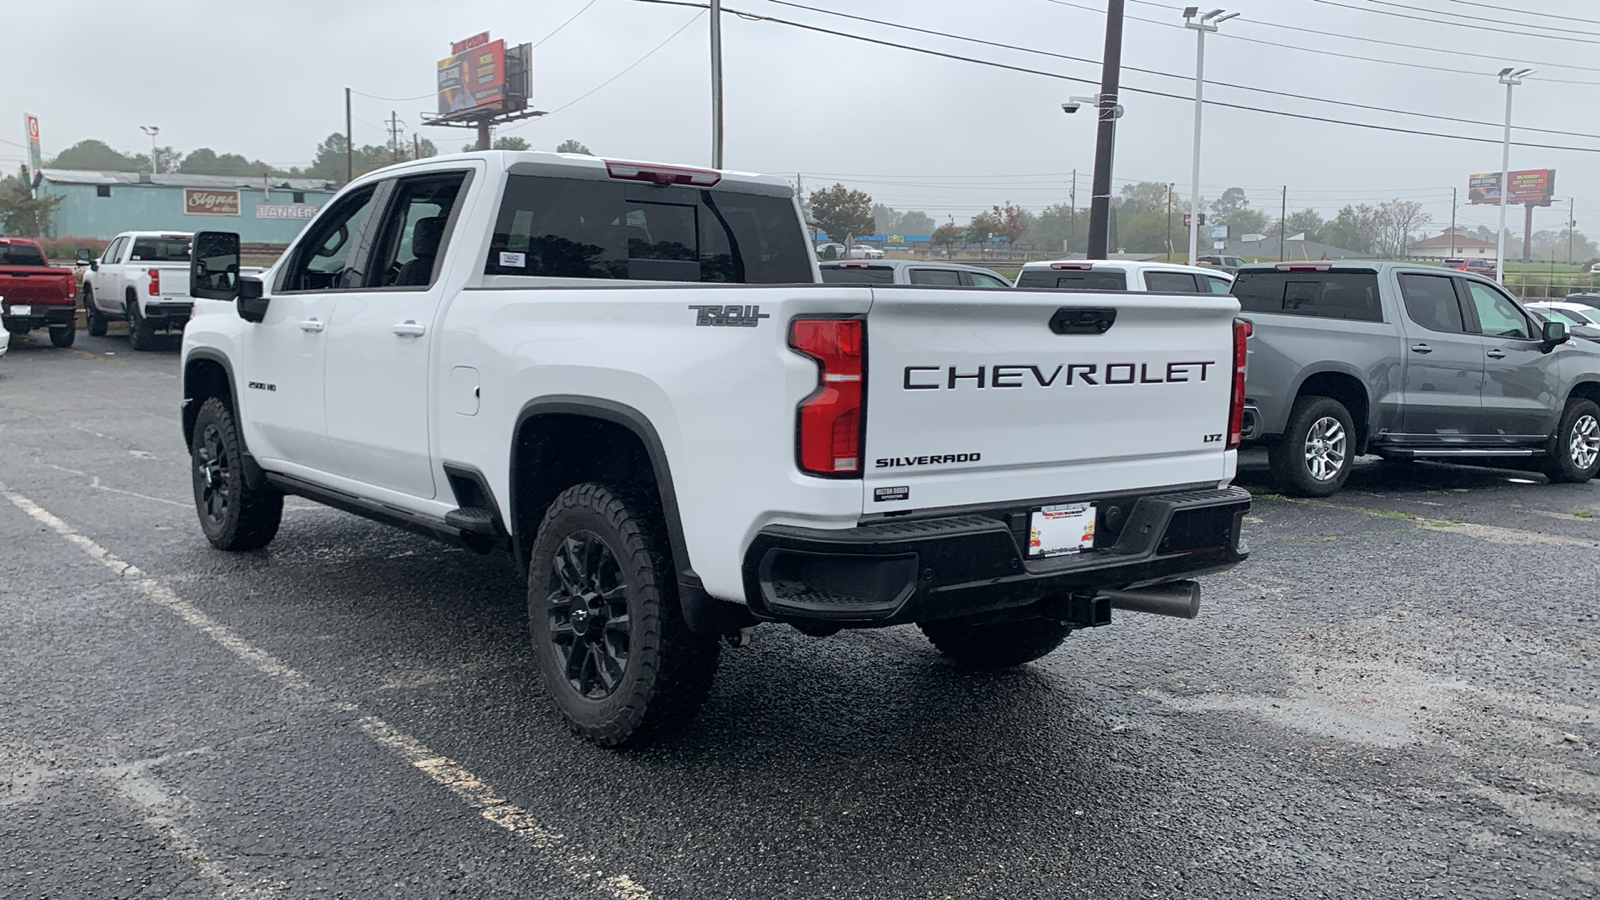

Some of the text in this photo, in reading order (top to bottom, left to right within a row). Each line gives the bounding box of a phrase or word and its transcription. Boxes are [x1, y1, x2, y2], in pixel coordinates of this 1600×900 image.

[188, 192, 235, 208] Signs
[688, 305, 770, 318] TRAIL
[696, 317, 758, 327] BOSS
[903, 361, 1215, 390] CHEVROLET
[248, 381, 276, 392] 2500 HD
[1203, 433, 1222, 442] LTZ
[875, 452, 981, 468] SILVERADO
